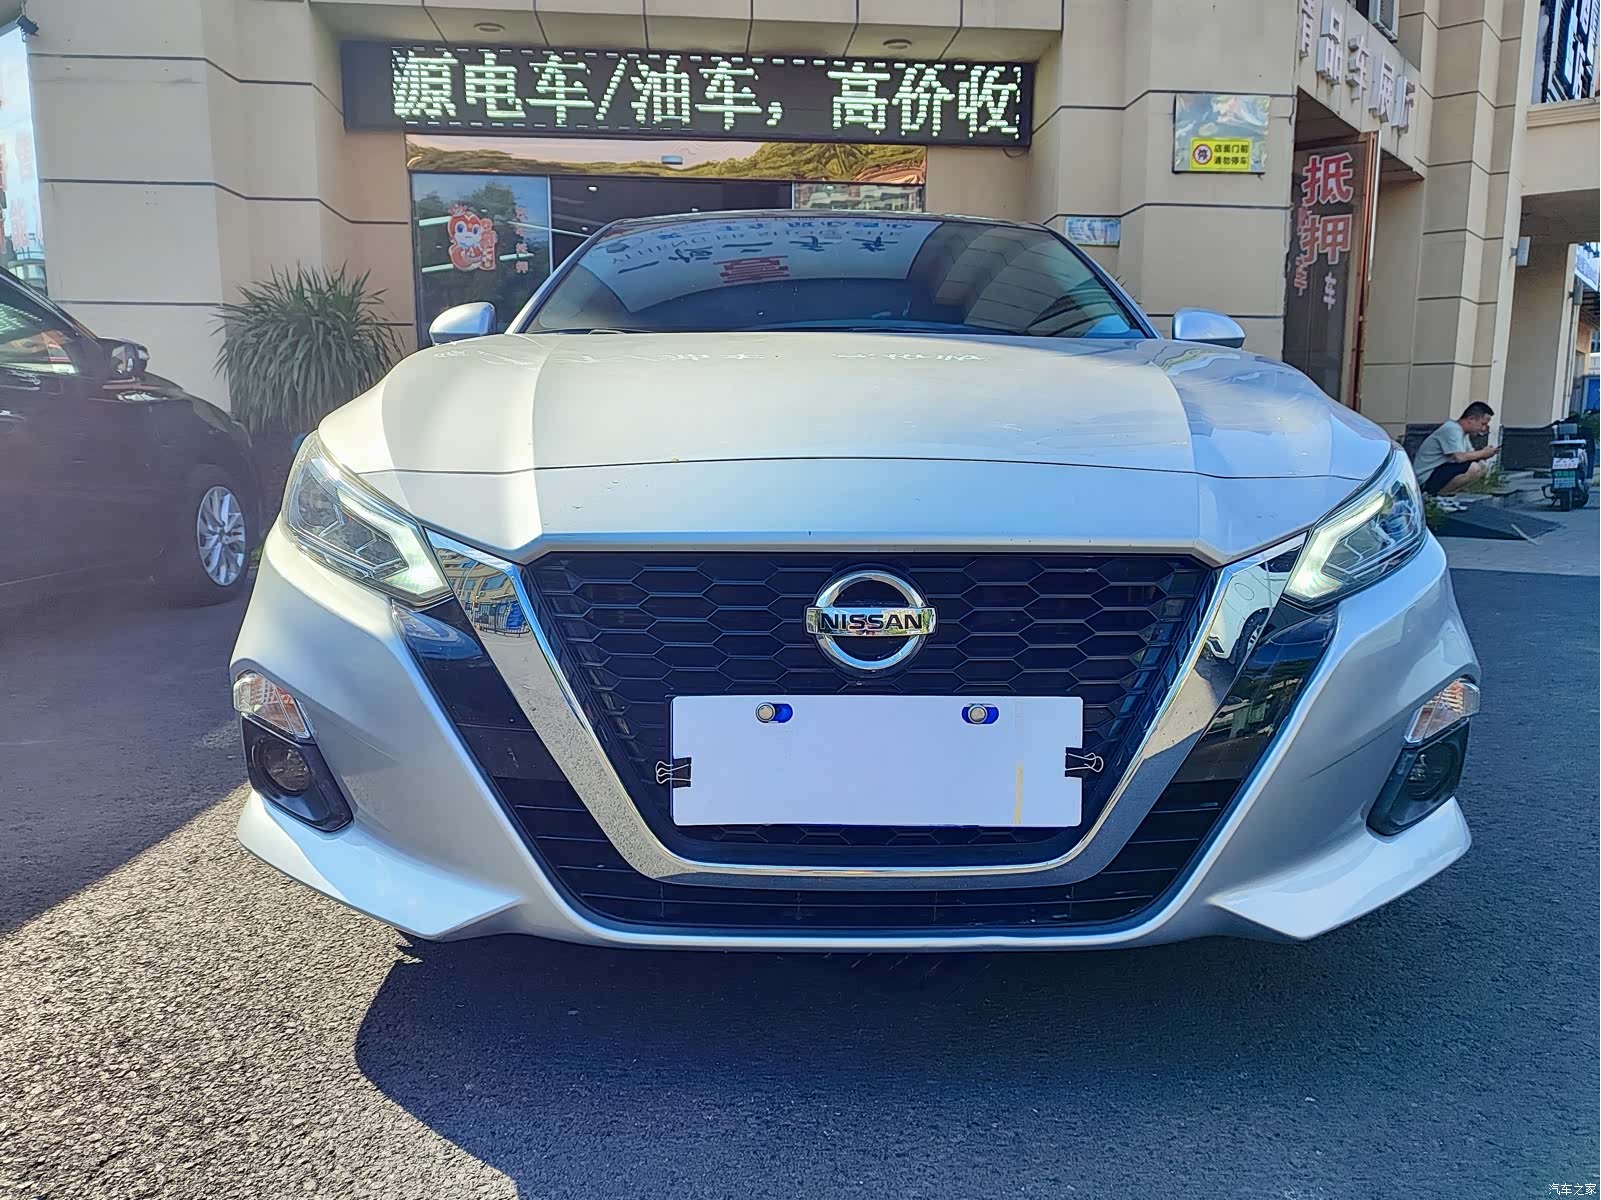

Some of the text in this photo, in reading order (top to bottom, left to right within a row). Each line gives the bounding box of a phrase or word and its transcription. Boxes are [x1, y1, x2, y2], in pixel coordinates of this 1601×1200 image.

[1214, 156, 1249, 166] 请勿停车
[819, 612, 923, 630] NISSAN
